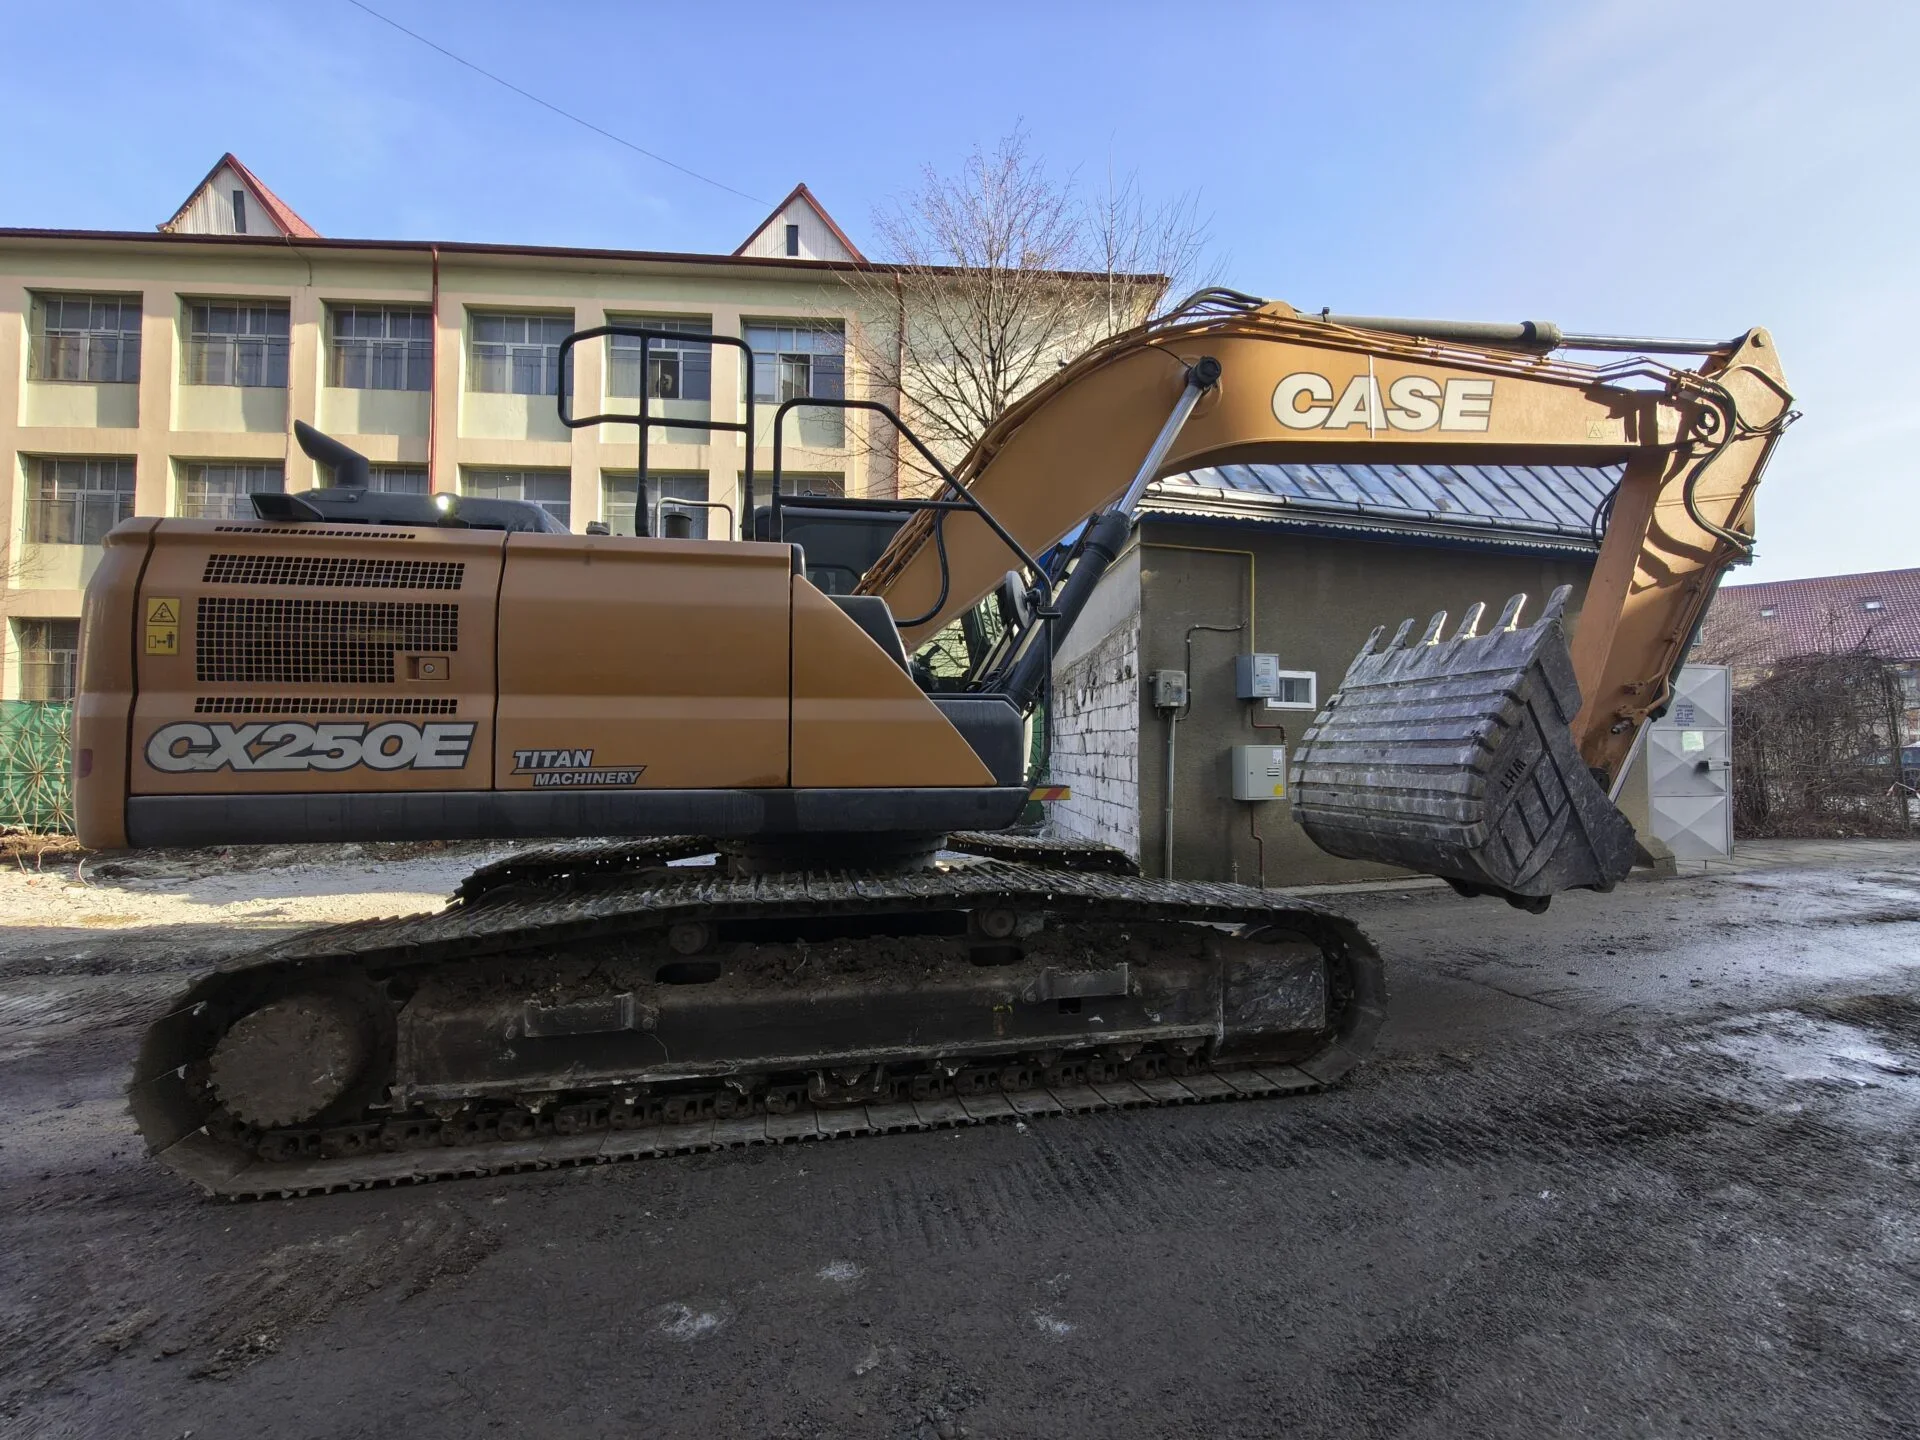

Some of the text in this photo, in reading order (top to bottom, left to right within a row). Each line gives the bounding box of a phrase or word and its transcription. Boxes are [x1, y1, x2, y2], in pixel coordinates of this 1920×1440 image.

[1272, 372, 1494, 431] CASE
[146, 721, 477, 772] CX250E
[514, 750, 593, 768] TITAN
[534, 772, 642, 785] MACHINERY
